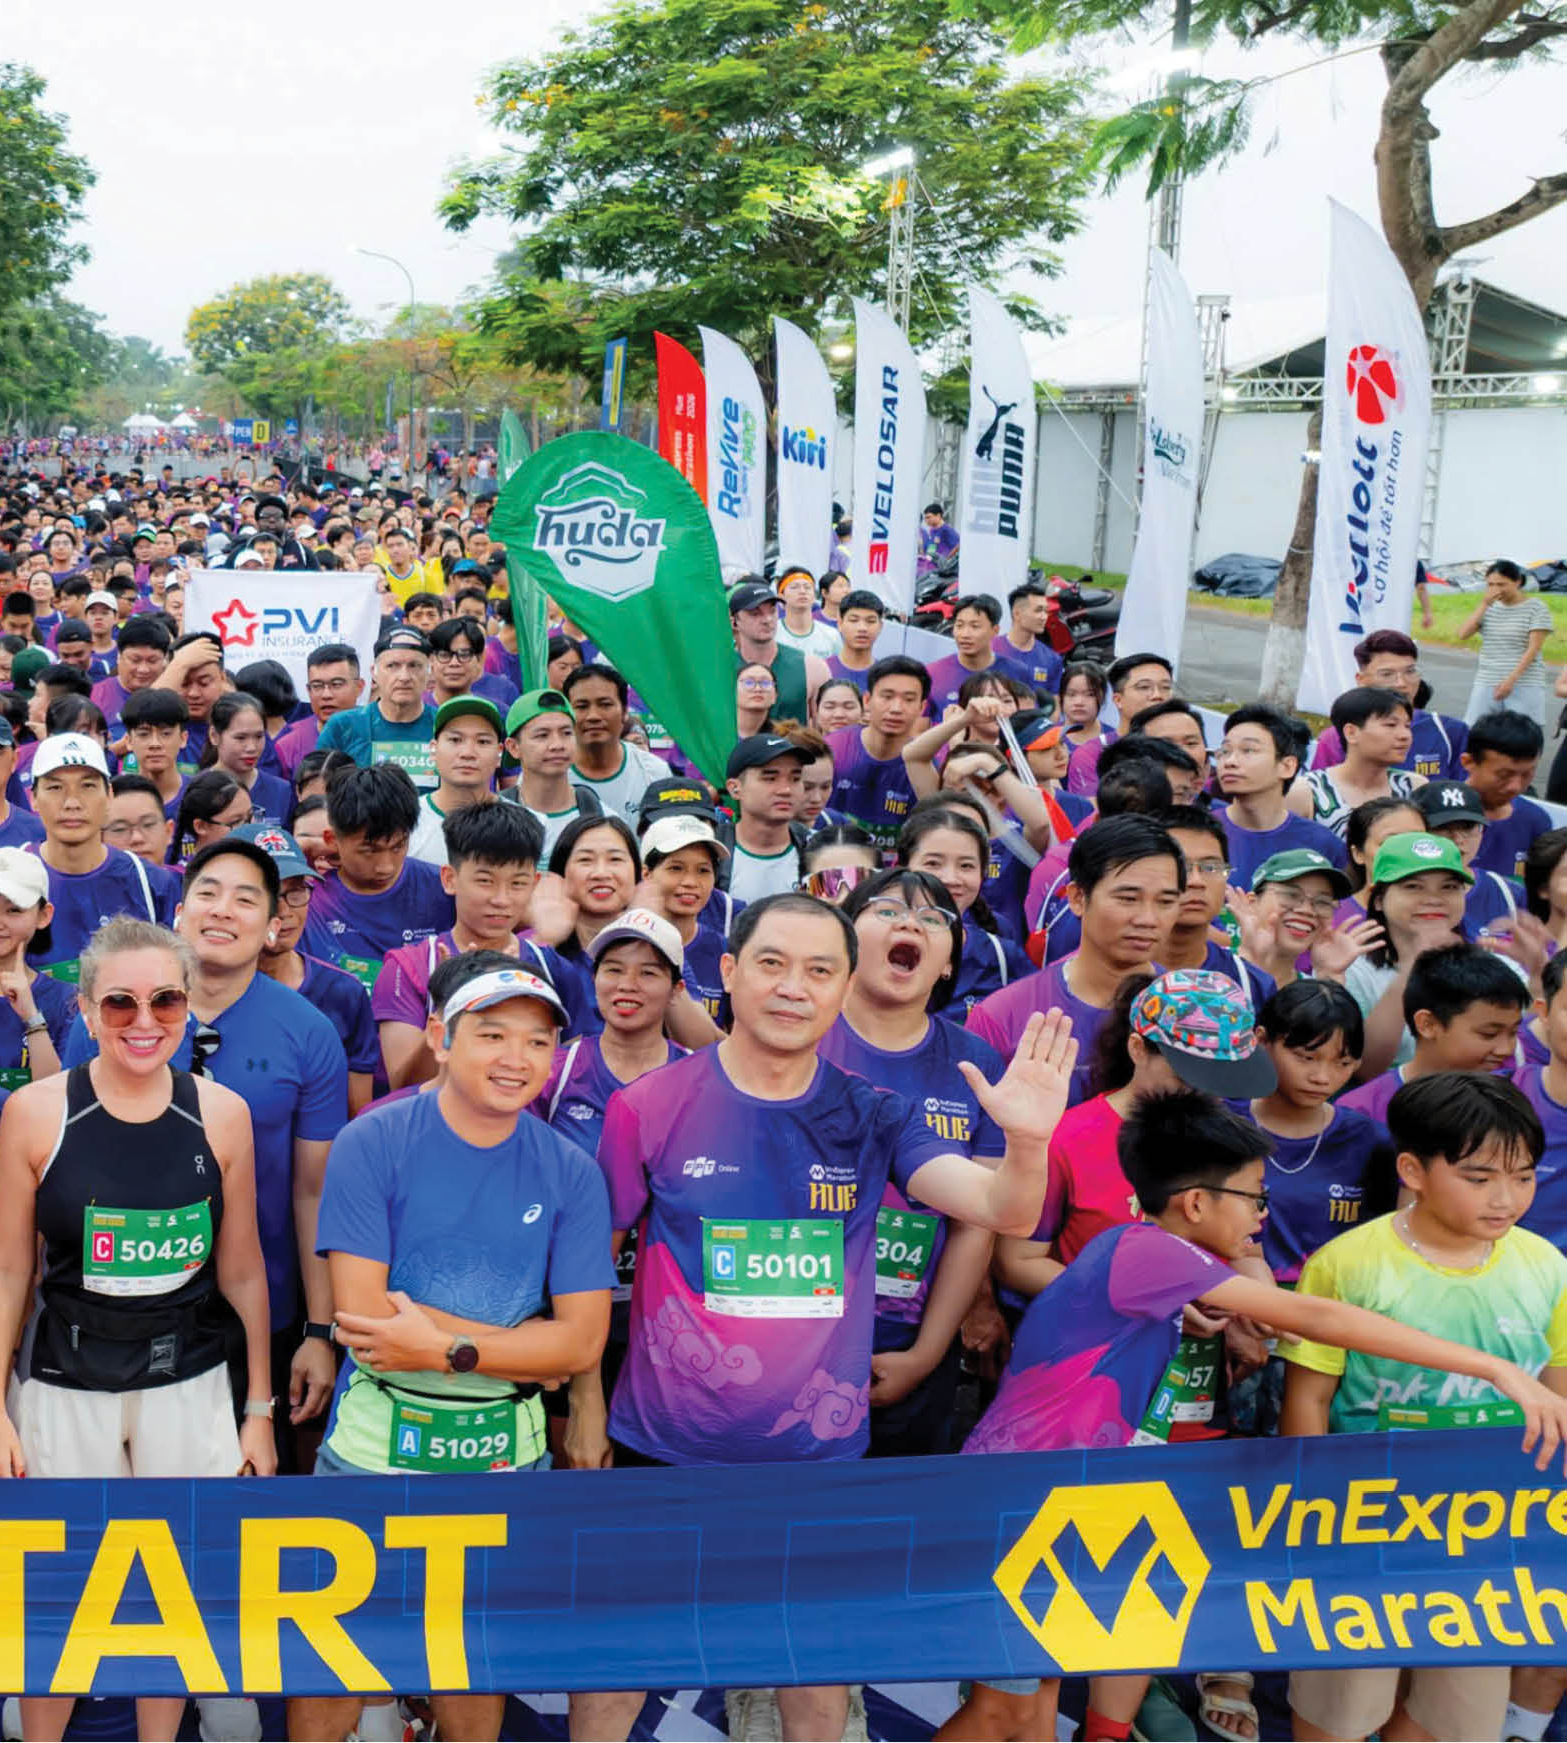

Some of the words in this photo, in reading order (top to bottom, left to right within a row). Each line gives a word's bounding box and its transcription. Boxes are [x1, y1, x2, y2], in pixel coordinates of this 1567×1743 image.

[872, 366, 899, 541] VELOSAR
[997, 422, 1025, 539] PUMA
[262, 607, 339, 635] PVI
[808, 1182, 858, 1212] HUE
[120, 1234, 205, 1262] 50426
[716, 1249, 732, 1276] C
[746, 1253, 831, 1279] 50101
[1185, 1364, 1215, 1388] 57
[428, 1432, 510, 1460] 51029
